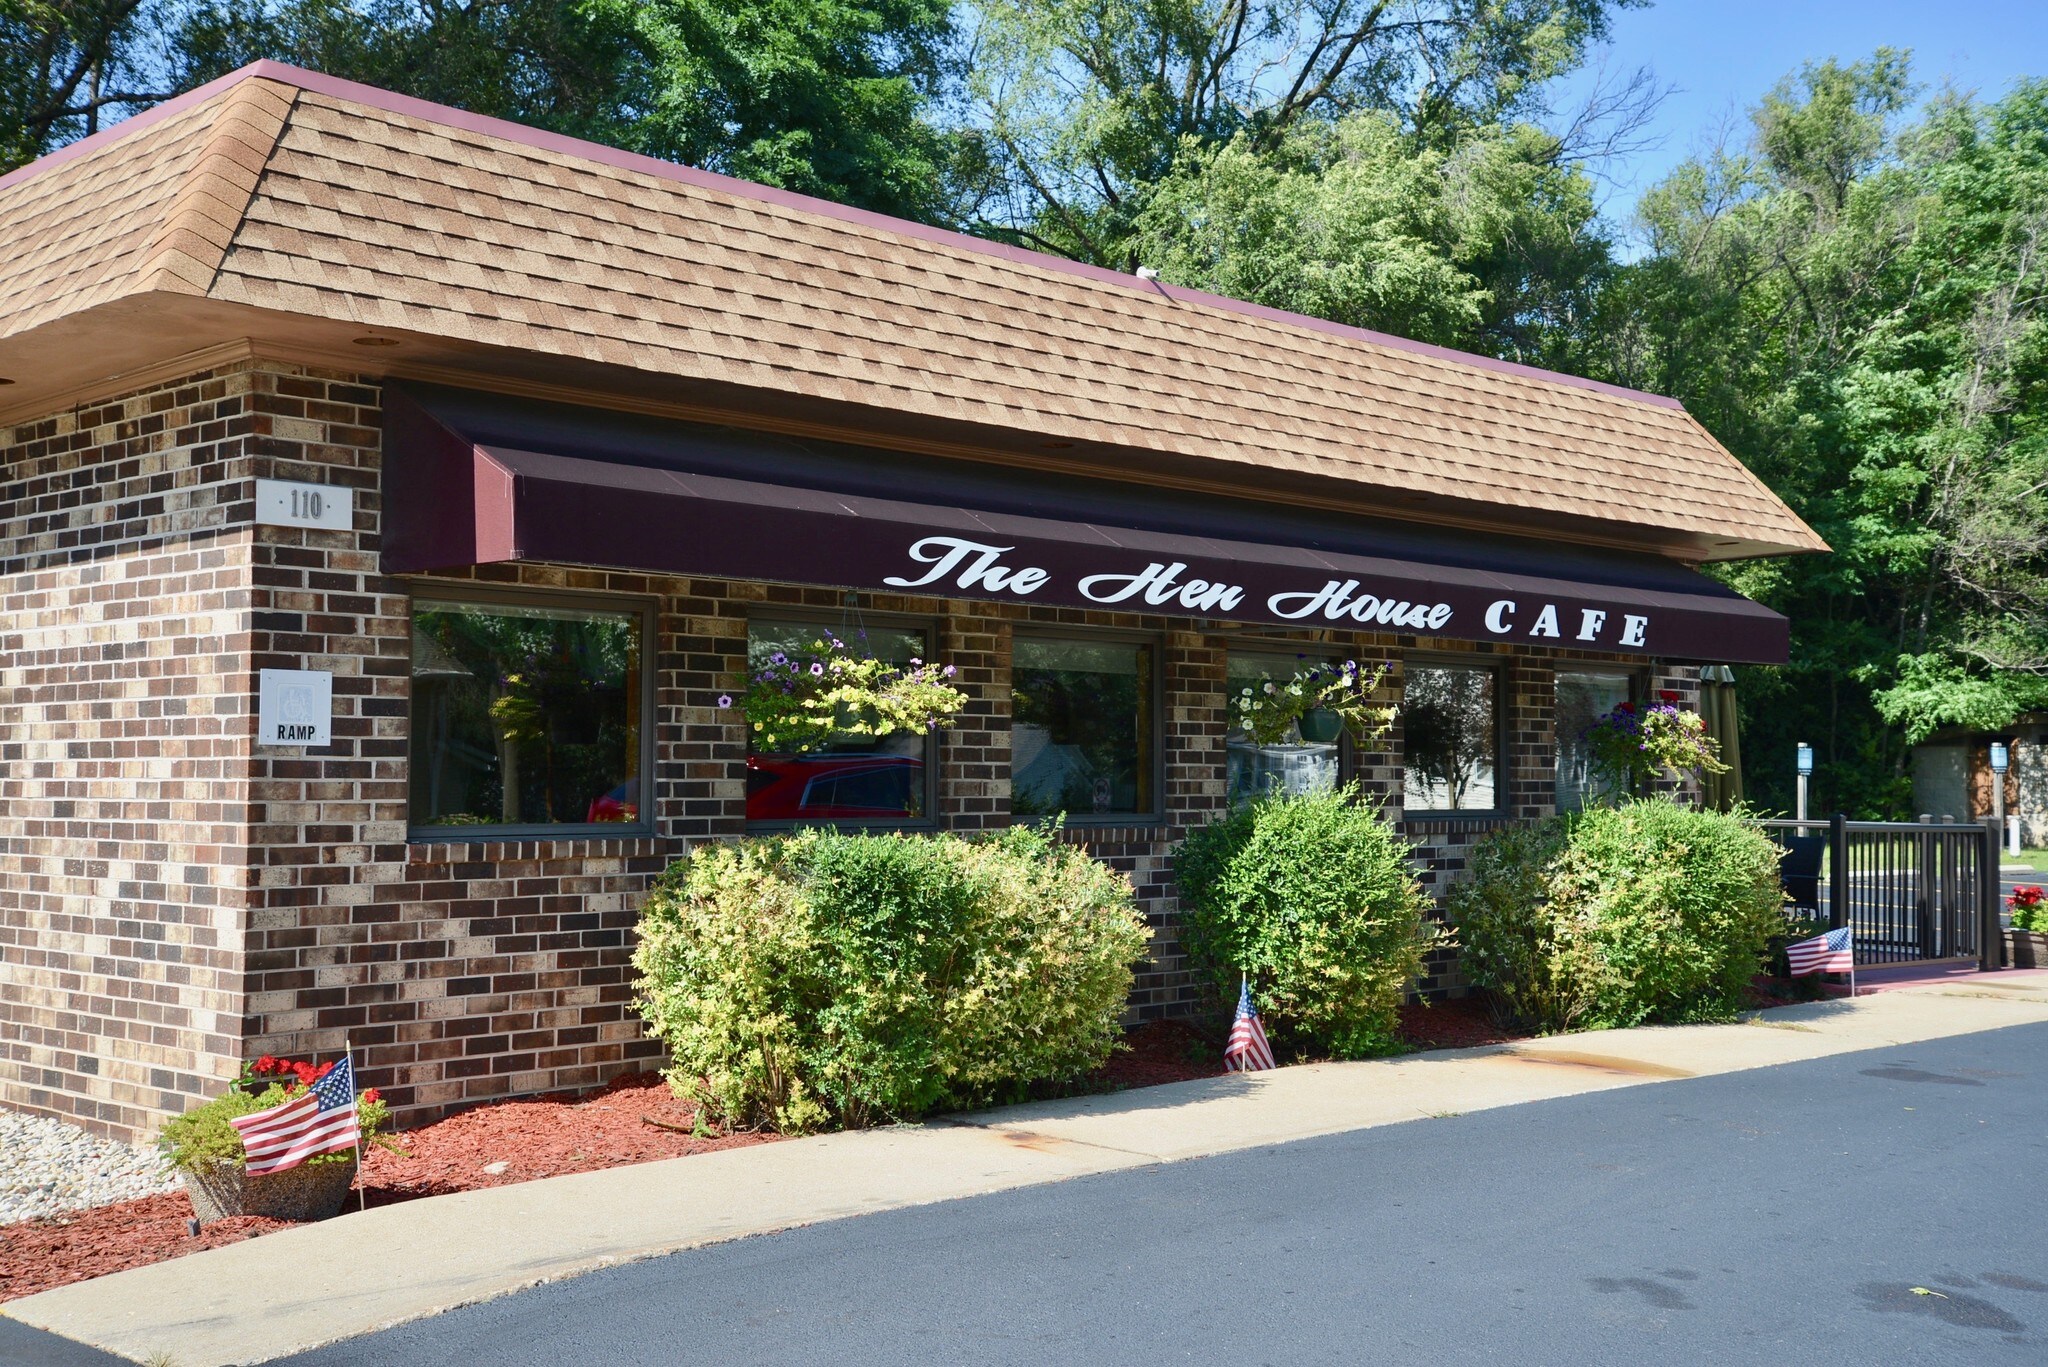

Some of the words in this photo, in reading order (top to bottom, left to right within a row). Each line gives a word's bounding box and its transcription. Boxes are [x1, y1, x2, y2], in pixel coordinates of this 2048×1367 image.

[290, 488, 322, 519] 110
[882, 536, 1051, 595] The
[1078, 562, 1245, 611] Hen
[1267, 579, 1453, 630] House
[1484, 600, 1648, 647] CAFE
[277, 724, 316, 740] RAMP
